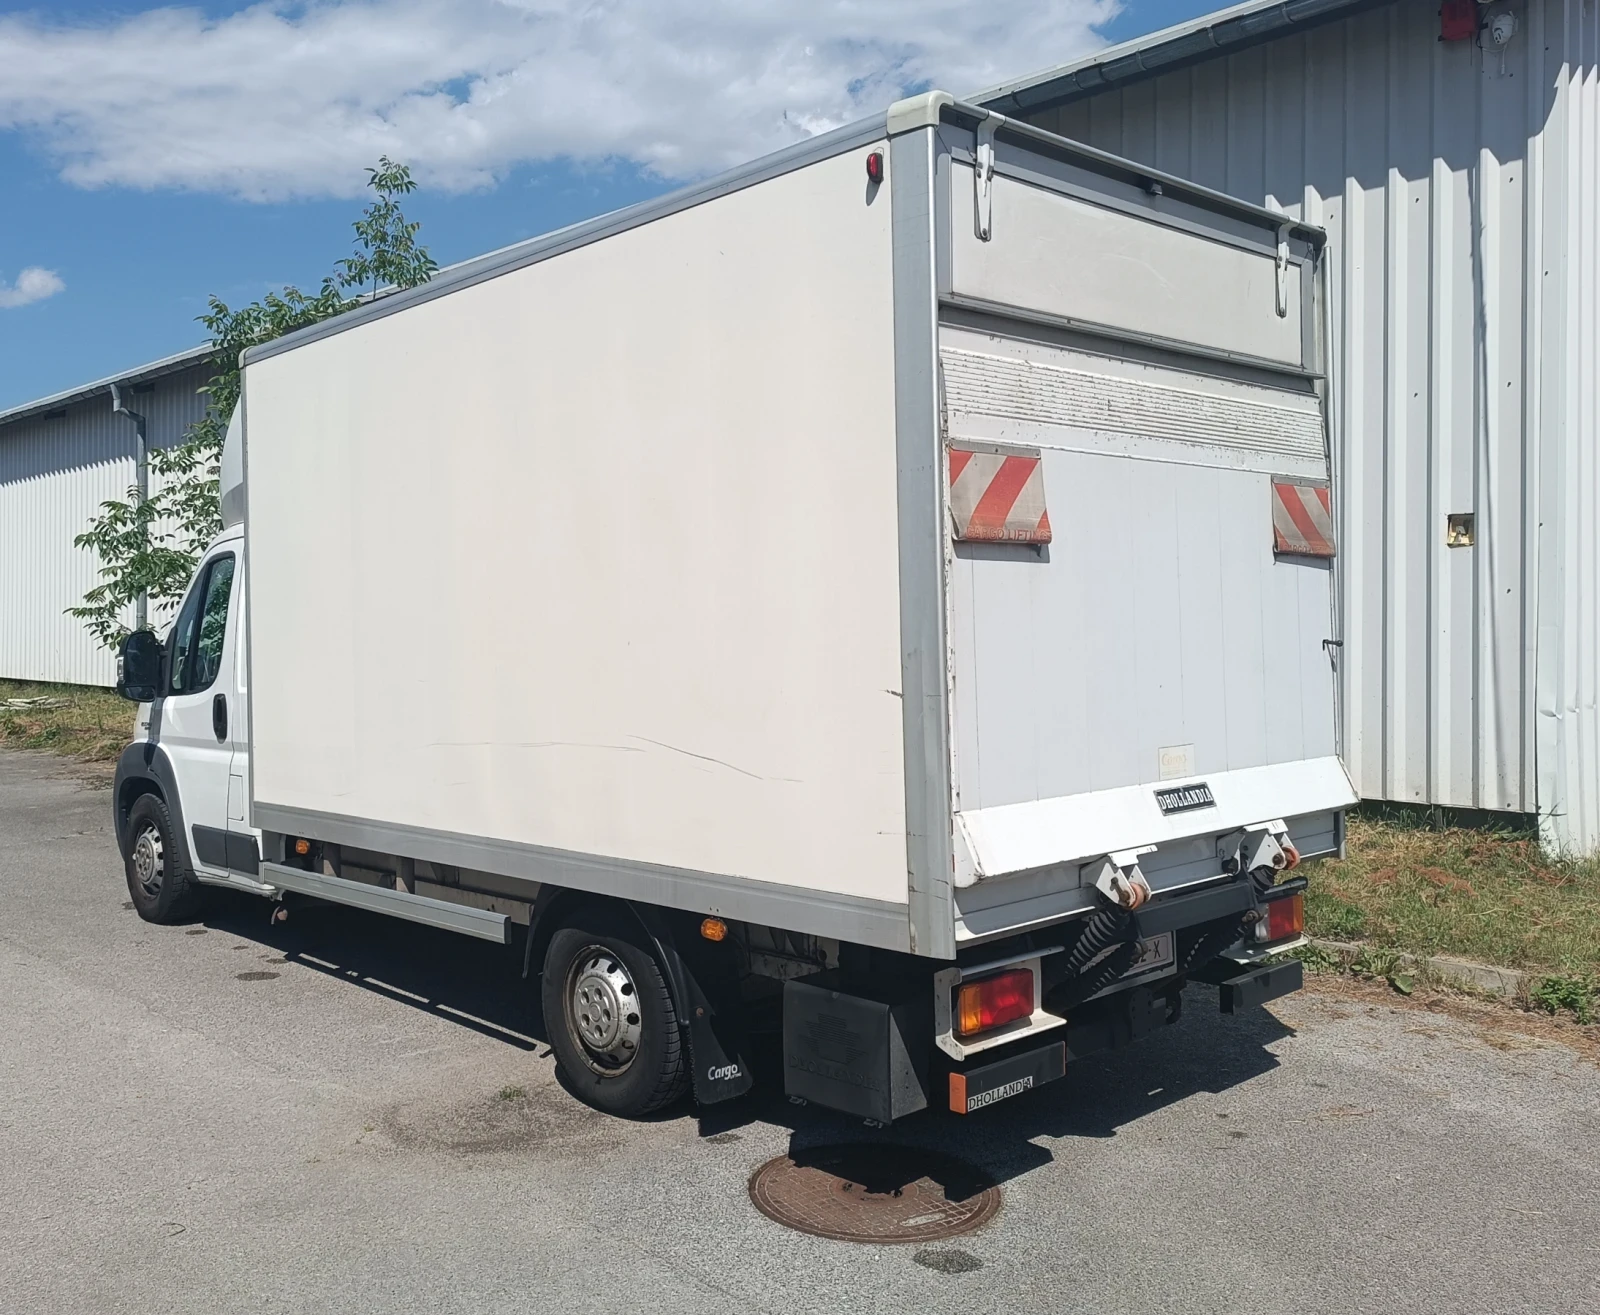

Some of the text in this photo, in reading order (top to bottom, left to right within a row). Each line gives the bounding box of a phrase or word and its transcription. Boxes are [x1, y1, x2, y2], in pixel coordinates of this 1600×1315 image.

[966, 526, 1005, 541] CARGO
[1157, 787, 1214, 810] DHOLLANDIA
[708, 1064, 738, 1081] Cargo
